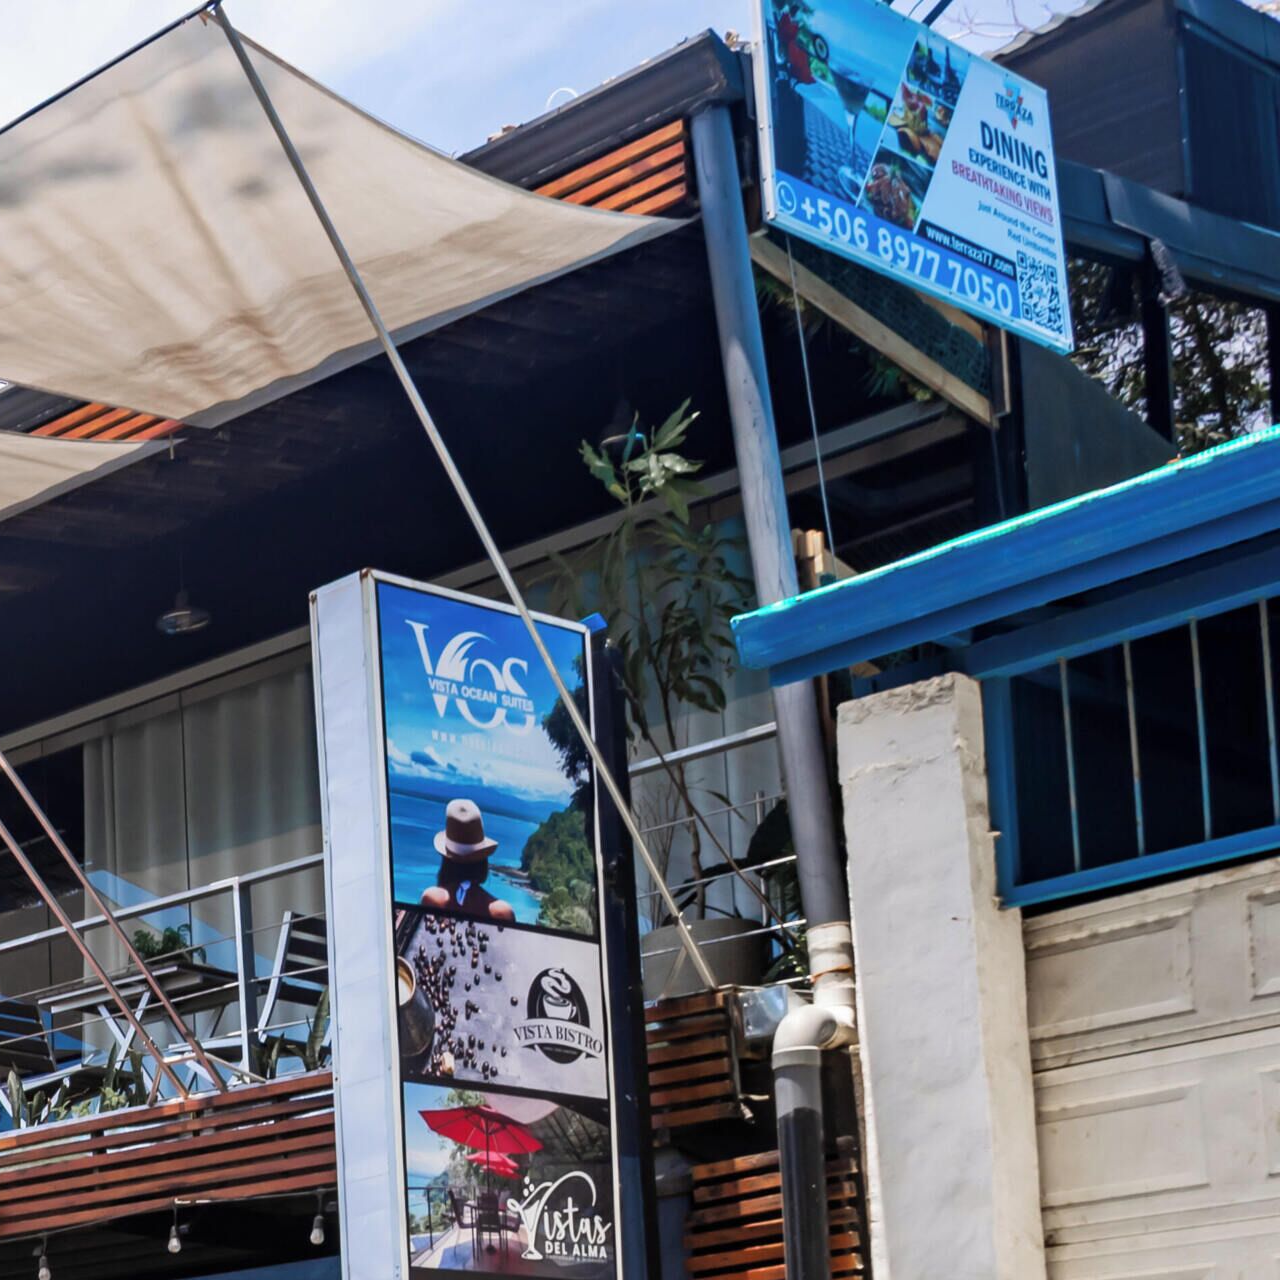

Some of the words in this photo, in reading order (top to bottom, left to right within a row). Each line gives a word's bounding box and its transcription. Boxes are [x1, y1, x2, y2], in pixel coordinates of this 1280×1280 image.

[969, 148, 1026, 189] EXPERIENCE
[1027, 178, 1051, 200] WITH
[980, 120, 1048, 178] DINING
[952, 160, 1022, 207] BREATHTAKING
[1024, 195, 1053, 223] VIEWS
[801, 197, 869, 250] +506
[878, 228, 940, 282] 8977
[948, 259, 1013, 316] 7050
[404, 619, 536, 735] VOS
[428, 677, 459, 696] VISTA
[461, 685, 497, 704] OCEAN
[501, 694, 534, 712] SUITES
[513, 1024, 553, 1041] VISTA
[555, 1025, 603, 1054] BISTRO
[507, 1171, 612, 1260] Vistas
[544, 1240, 568, 1255] DEL
[572, 1243, 608, 1259] ALMA
